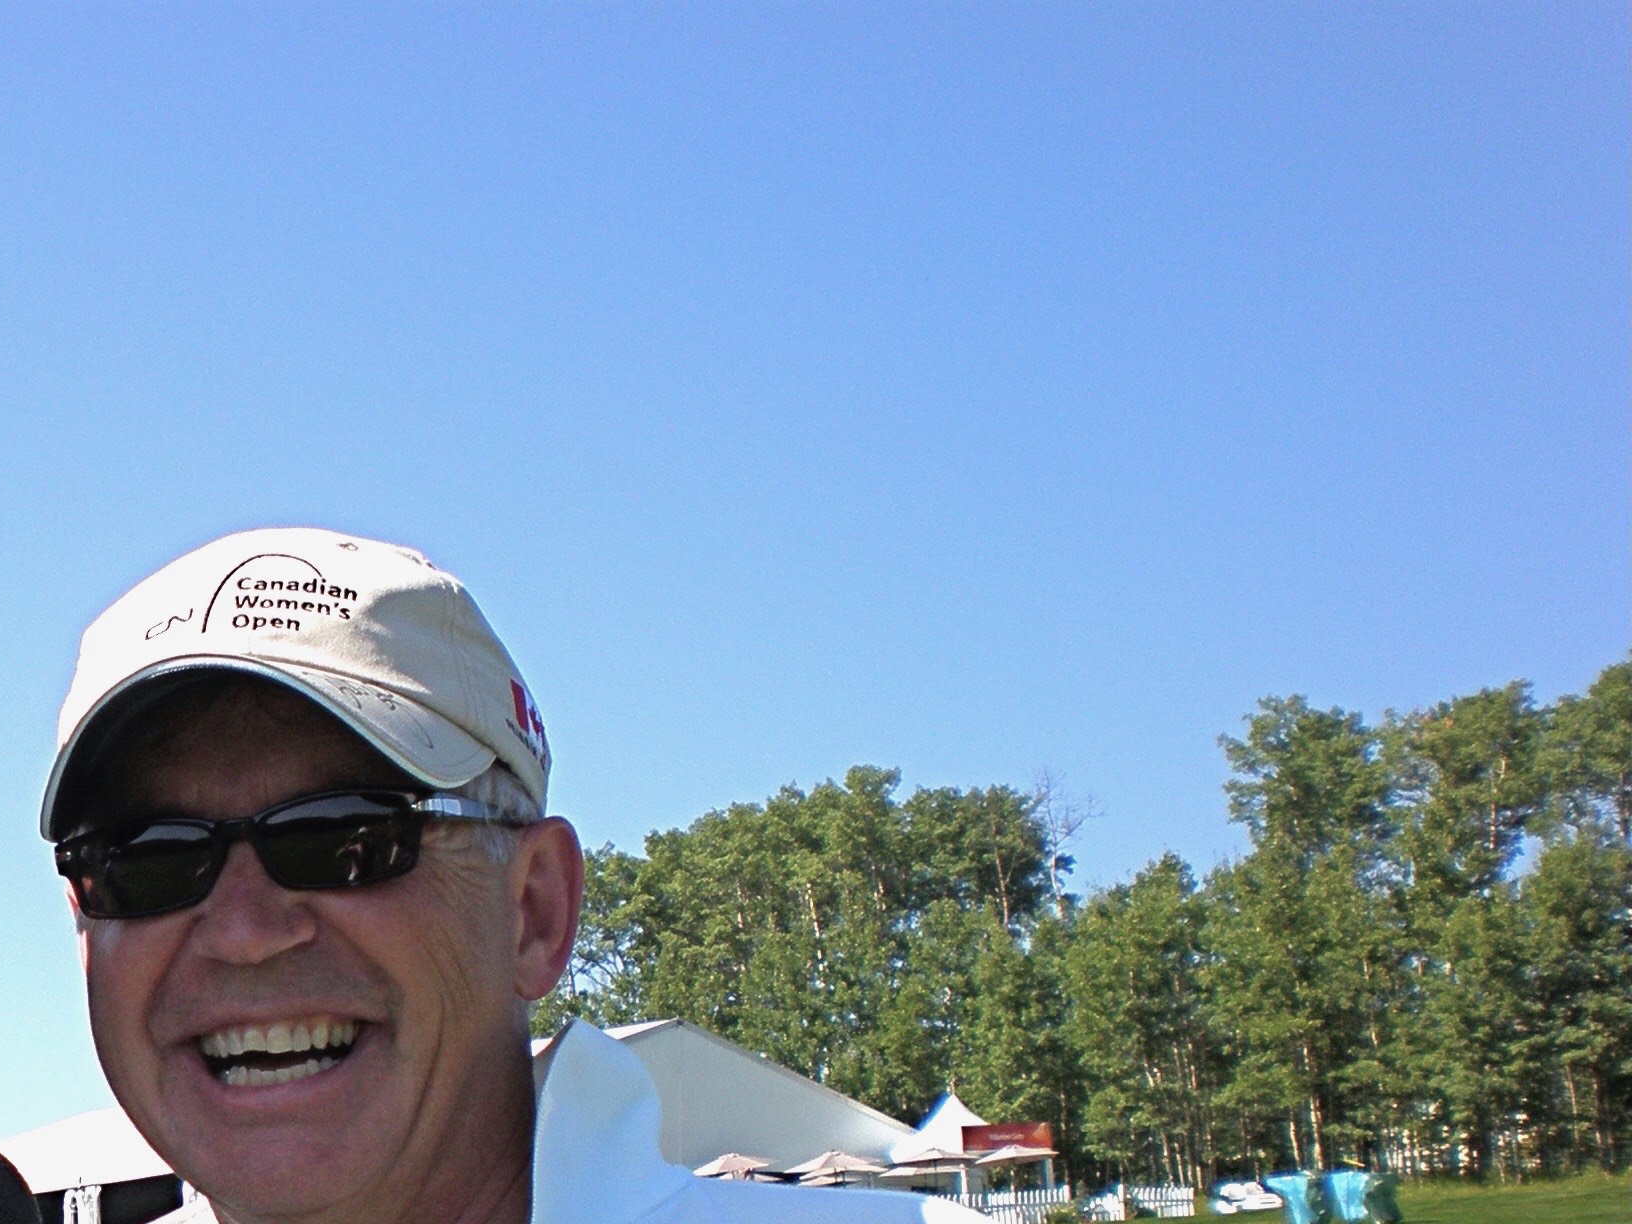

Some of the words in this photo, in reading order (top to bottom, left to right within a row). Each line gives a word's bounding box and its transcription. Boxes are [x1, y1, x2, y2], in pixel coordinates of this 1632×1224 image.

[236, 577, 358, 601] Canadian
[234, 595, 352, 620] Women's
[232, 613, 301, 631] Open
